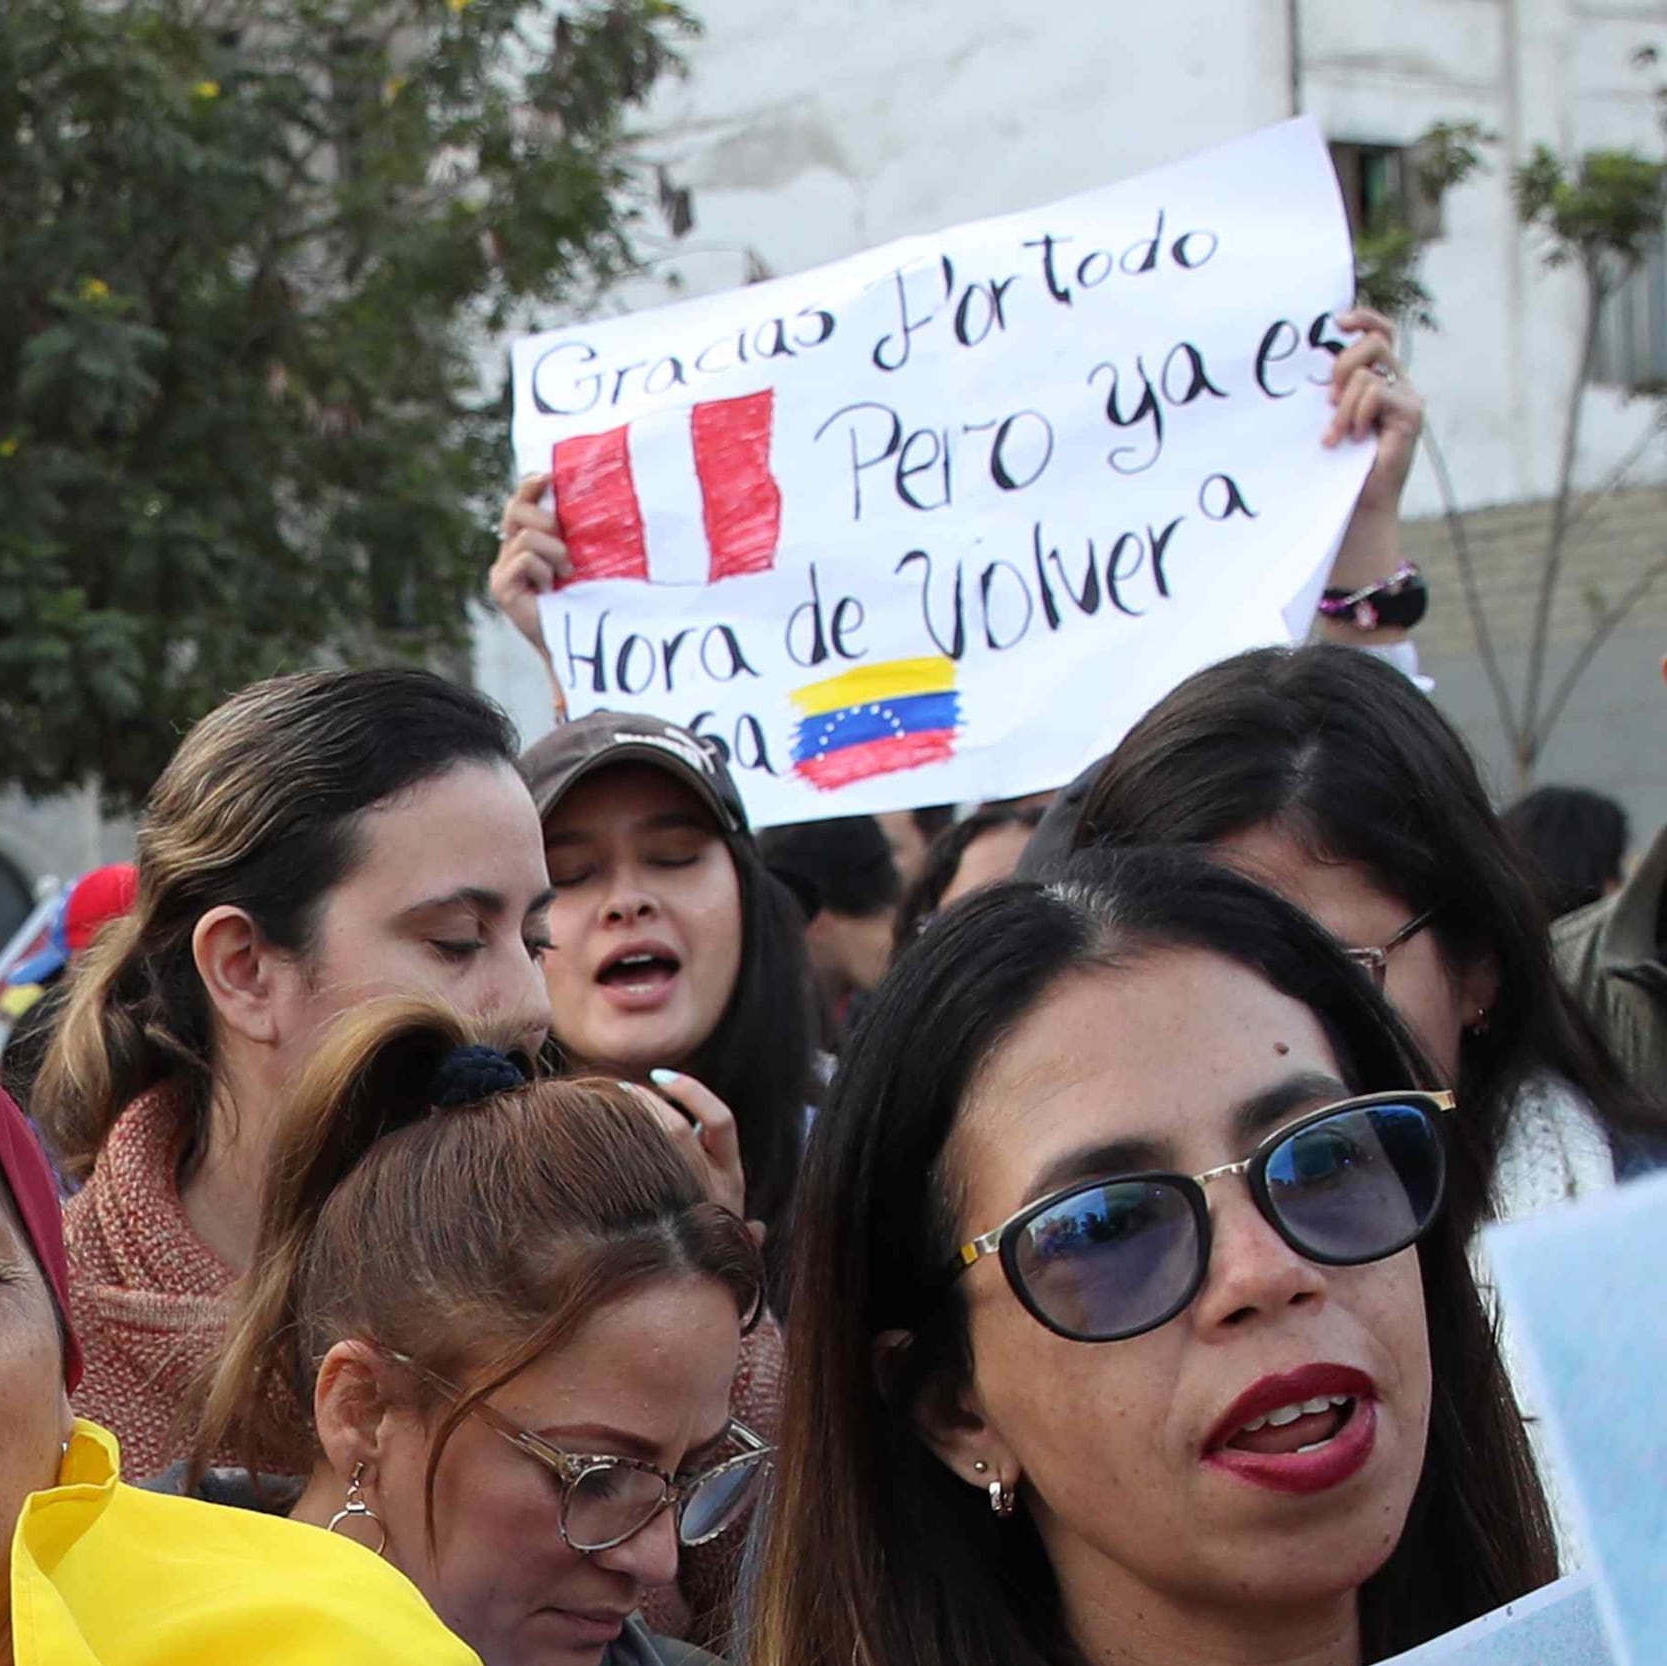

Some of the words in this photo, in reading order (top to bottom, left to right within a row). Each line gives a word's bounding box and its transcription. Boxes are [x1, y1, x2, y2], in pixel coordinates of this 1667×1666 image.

[531, 306, 836, 415] Gracias
[814, 401, 1054, 520] Pero
[1087, 341, 1230, 476] ya
[1253, 311, 1347, 400] es
[563, 610, 760, 695] Hora
[784, 562, 867, 668] de
[1198, 472, 1259, 521] a
